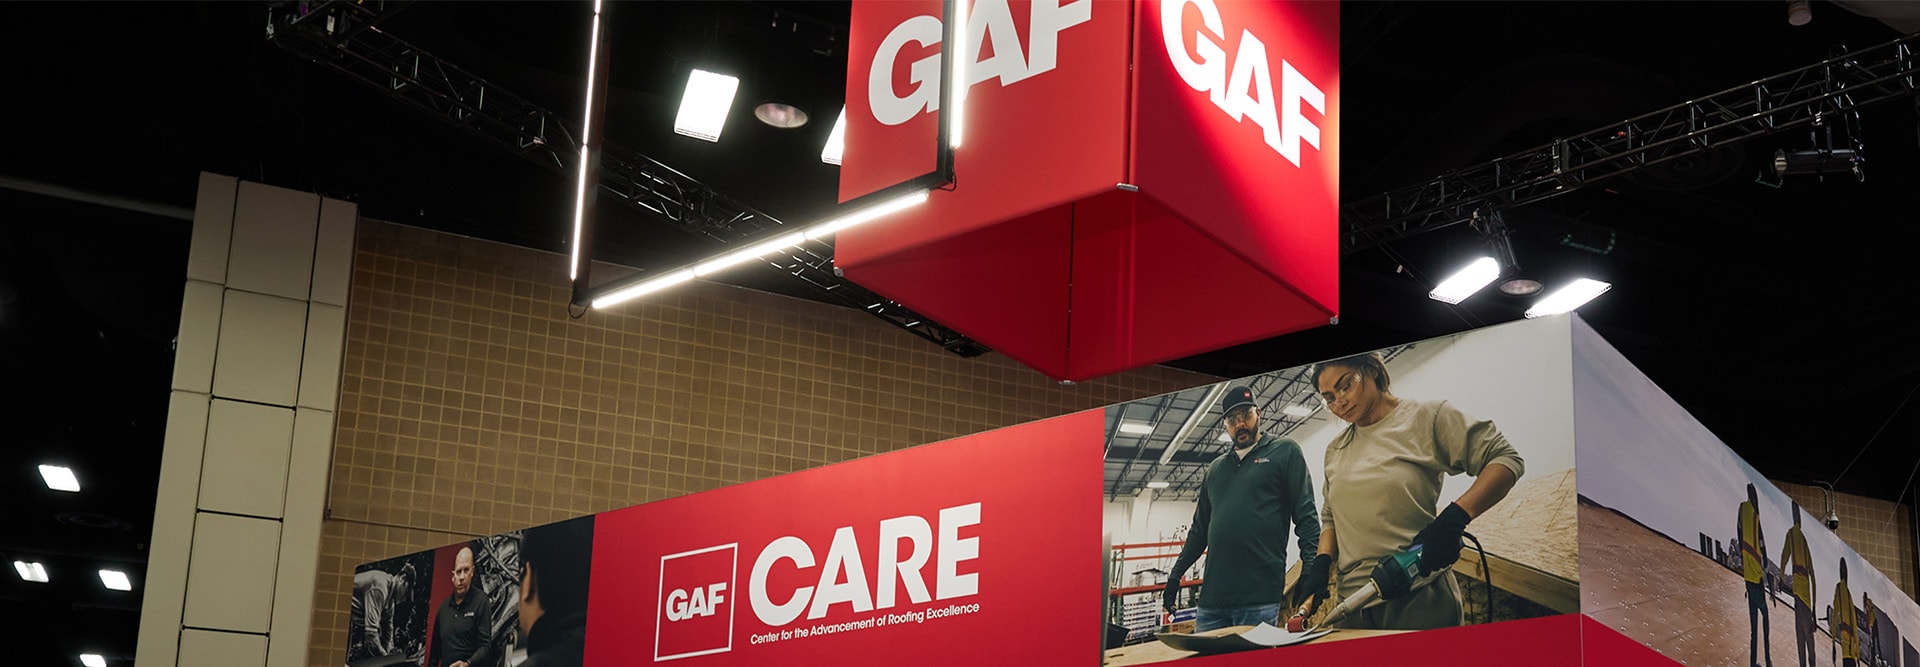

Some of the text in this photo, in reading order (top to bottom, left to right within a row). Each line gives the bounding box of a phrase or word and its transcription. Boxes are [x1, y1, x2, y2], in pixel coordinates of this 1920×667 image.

[868, 0, 1092, 126] GAF
[1160, 0, 1326, 169] GAF
[665, 582, 727, 622] GAF
[749, 502, 981, 626] CARE
[750, 603, 980, 645] Center for the Advancement of Roofing Excellence
